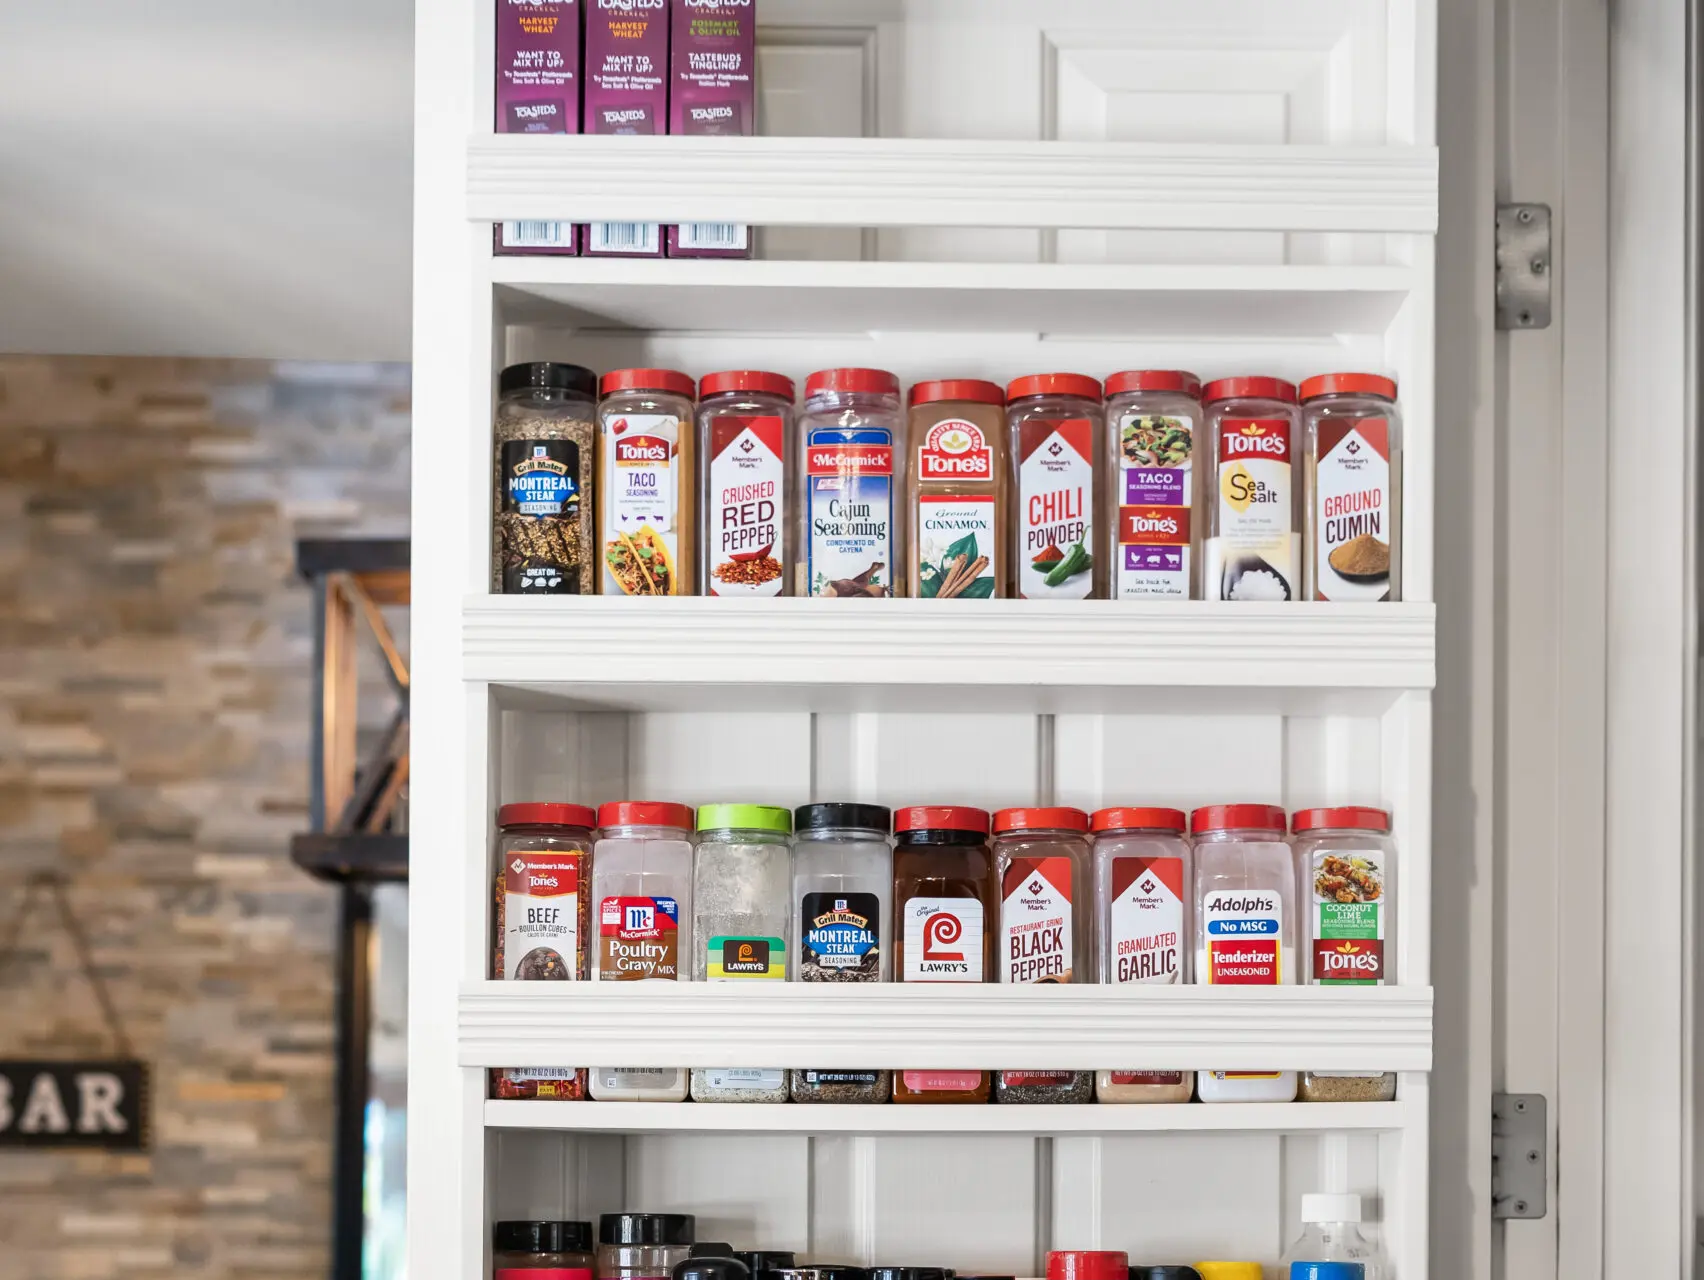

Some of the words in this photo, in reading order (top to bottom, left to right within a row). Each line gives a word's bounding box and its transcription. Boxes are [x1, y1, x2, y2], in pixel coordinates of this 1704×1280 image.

[519, 17, 559, 25] HARVEST
[608, 21, 648, 31] HARVEST
[691, 20, 739, 28] ROSEMARY
[523, 25, 554, 34] WHEAT
[612, 30, 644, 39] WHEAT
[689, 28, 696, 36] &
[698, 28, 723, 36] OLIVE
[726, 28, 741, 36] OIL
[517, 51, 544, 60] WANT
[547, 51, 561, 60] TO
[606, 55, 634, 64] WANT
[636, 55, 650, 64] TO
[688, 52, 742, 62] TASTEBUDS
[512, 59, 532, 68] MIX
[534, 59, 544, 68] IT
[546, 59, 564, 68] UP?
[602, 63, 620, 72] MIX
[623, 63, 633, 72] IT
[635, 63, 654, 73] UP?
[689, 61, 740, 70] TINGLING?
[514, 104, 557, 118] TOASTEDS
[603, 109, 646, 124] TOASTEDS
[690, 107, 733, 120] TOASTEDS
[1222, 432, 1286, 455] Tone's
[618, 443, 666, 460] Tone's
[813, 453, 887, 467] McCormick
[923, 454, 988, 473] Tone's
[517, 461, 535, 473] Grill
[537, 461, 563, 473] Mates
[508, 477, 575, 491] MONTREAL
[628, 472, 656, 487] TACO
[1137, 473, 1174, 485] TACO
[626, 489, 659, 497] SEASONING
[722, 480, 775, 505] CRUSHED
[1230, 473, 1266, 501] Sea
[525, 491, 555, 501] STEAK
[1249, 490, 1278, 503] salt
[1029, 486, 1082, 526] CHILI
[1324, 488, 1381, 518] GROUND
[722, 500, 775, 530] RED
[829, 499, 870, 521] Cajun
[935, 509, 979, 518] Ground
[814, 518, 886, 540] Seasoning
[925, 519, 988, 530] CINNAMON
[1129, 516, 1178, 534] Tone's
[1326, 511, 1381, 544] CUMIN
[722, 524, 775, 552] PEPPER
[1028, 521, 1084, 551] POWDER
[826, 539, 866, 547] CONDIMENTO
[868, 539, 876, 547] DE
[838, 546, 863, 554] CAYENA
[526, 568, 545, 577] GREAT
[545, 568, 556, 577] ON
[527, 862, 558, 870] Member's
[528, 875, 559, 888] Tone's
[1132, 896, 1164, 904] Member's
[1207, 897, 1273, 914] Adolph's
[916, 905, 940, 917] Original
[1326, 904, 1373, 912] COCONUT
[527, 908, 560, 924] BEEF
[818, 913, 836, 925] Grill
[838, 914, 864, 925] Mates
[1336, 911, 1362, 920] LIME
[519, 924, 548, 934] BOUILLON
[548, 924, 567, 934] CUBES
[1009, 921, 1045, 935] RESTAURANT
[1046, 916, 1064, 927] GRIND
[1220, 921, 1238, 932] No
[1239, 921, 1268, 932] MSG
[620, 929, 659, 939] McCormick
[809, 929, 875, 944] MONTREAL
[826, 943, 855, 954] STEAK
[1010, 926, 1064, 961] BLACK
[1117, 931, 1177, 956] GRANULATED
[609, 940, 669, 962] Poultry
[1211, 949, 1275, 964] Tenderizer
[616, 957, 657, 975] Gravy
[657, 965, 675, 975] MIX
[727, 962, 764, 971] LAWRY'S
[1118, 948, 1177, 983] GARLIC
[1319, 950, 1379, 972] Tone's
[920, 963, 968, 973] LAWRY'S
[1011, 954, 1063, 984] PEPPER
[1217, 967, 1271, 977] UNSEASONED
